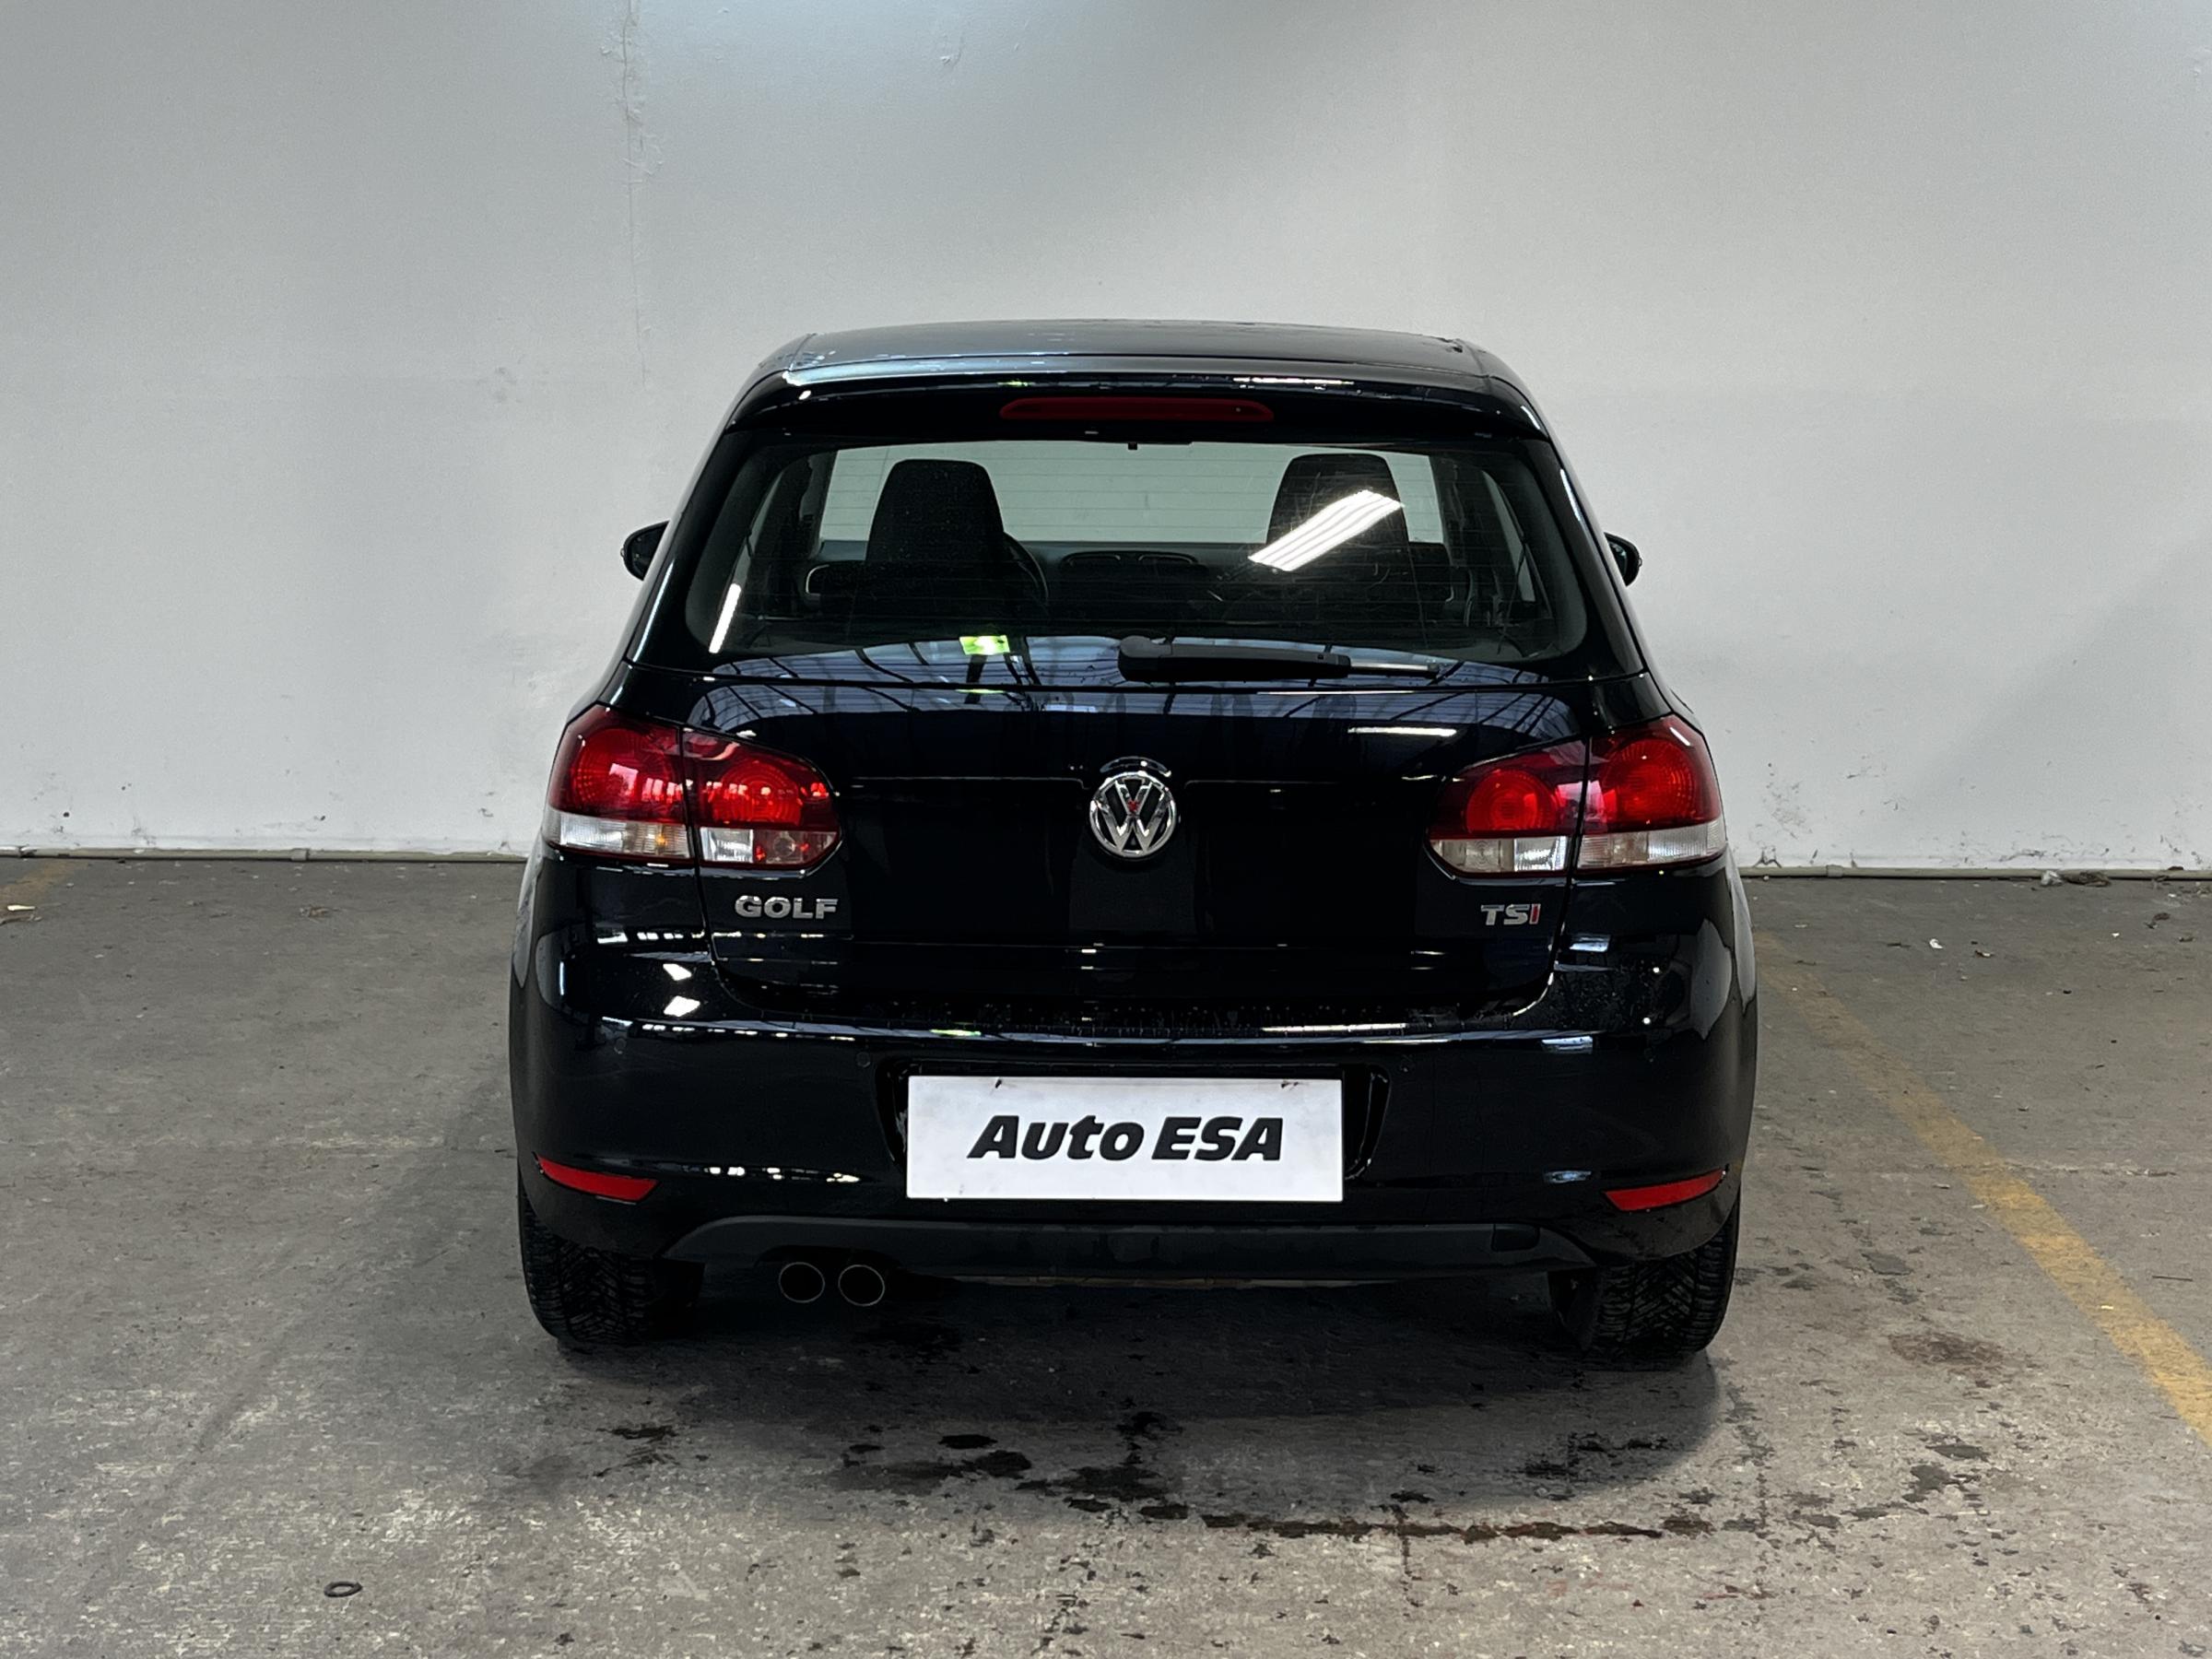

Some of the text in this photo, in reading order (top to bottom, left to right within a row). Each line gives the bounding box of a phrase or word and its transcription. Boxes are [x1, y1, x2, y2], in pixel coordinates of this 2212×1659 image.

[735, 895, 839, 920] GOLF
[1480, 903, 1541, 926] TSI
[967, 1114, 1283, 1161] Auto ESA
